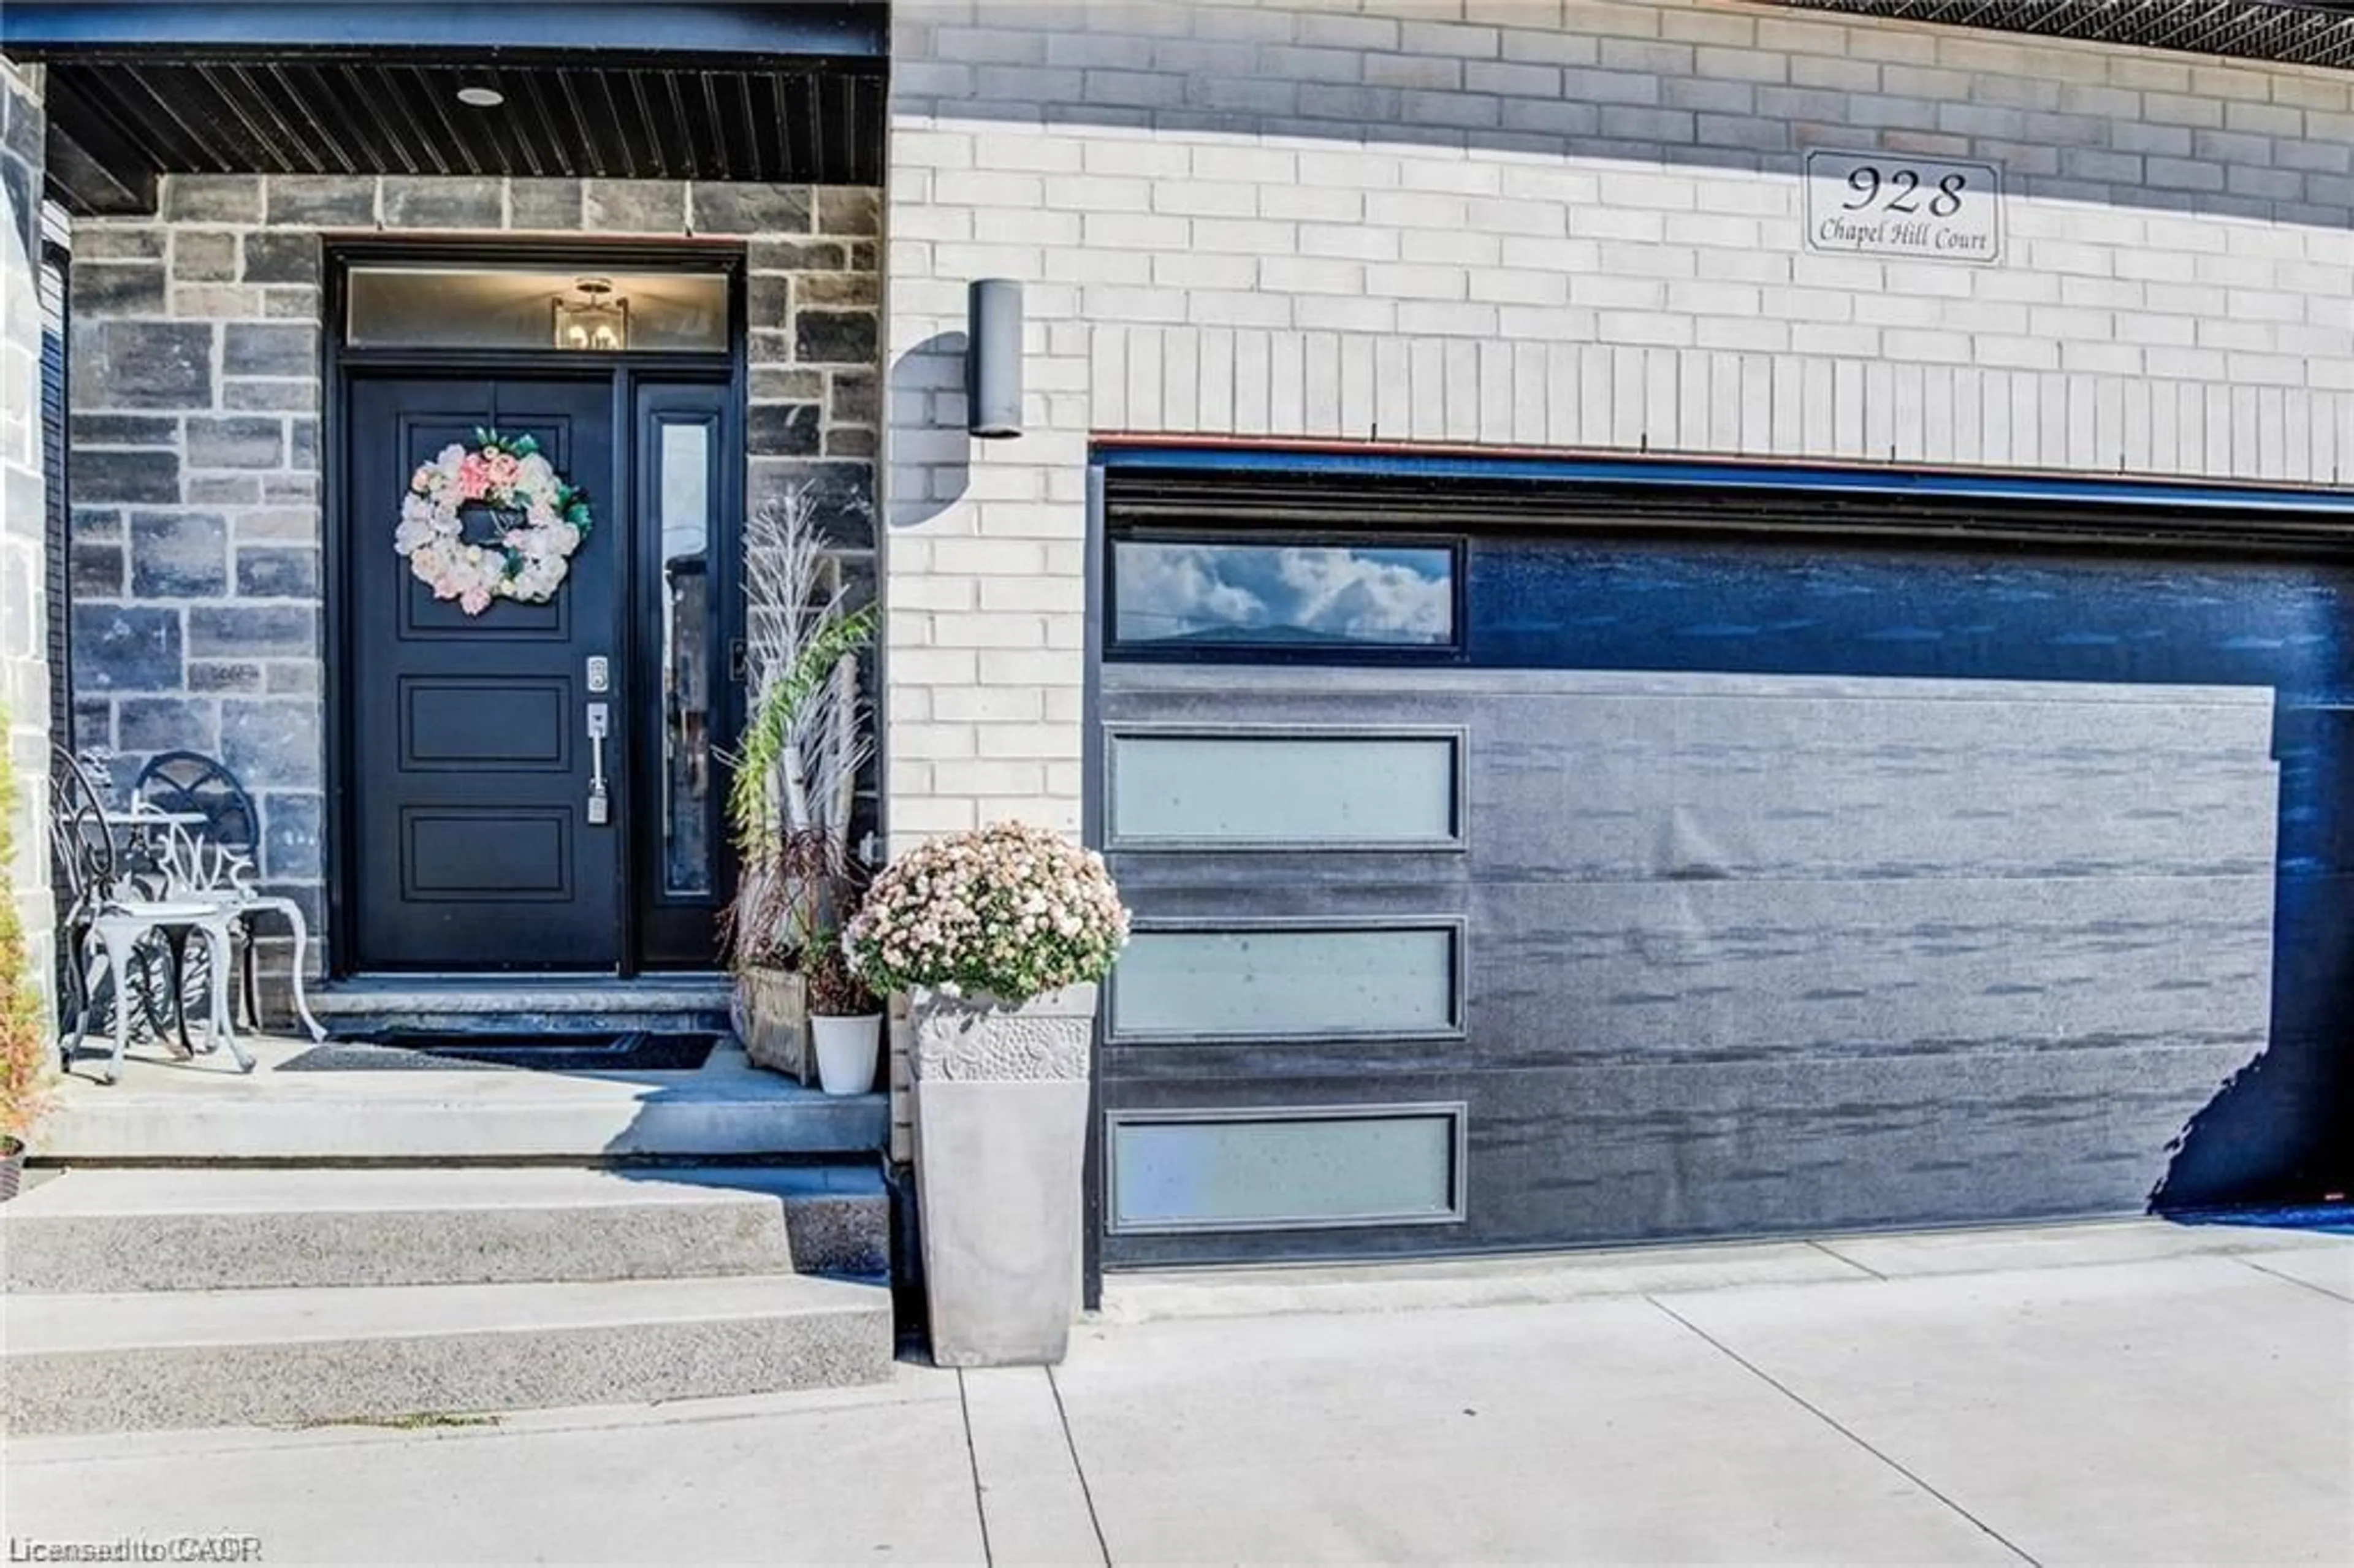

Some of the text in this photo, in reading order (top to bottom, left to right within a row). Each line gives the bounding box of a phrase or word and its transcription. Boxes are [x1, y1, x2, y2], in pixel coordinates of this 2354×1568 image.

[1842, 166, 1967, 217] 928
[1819, 217, 1987, 249] Chapel Hill Court
